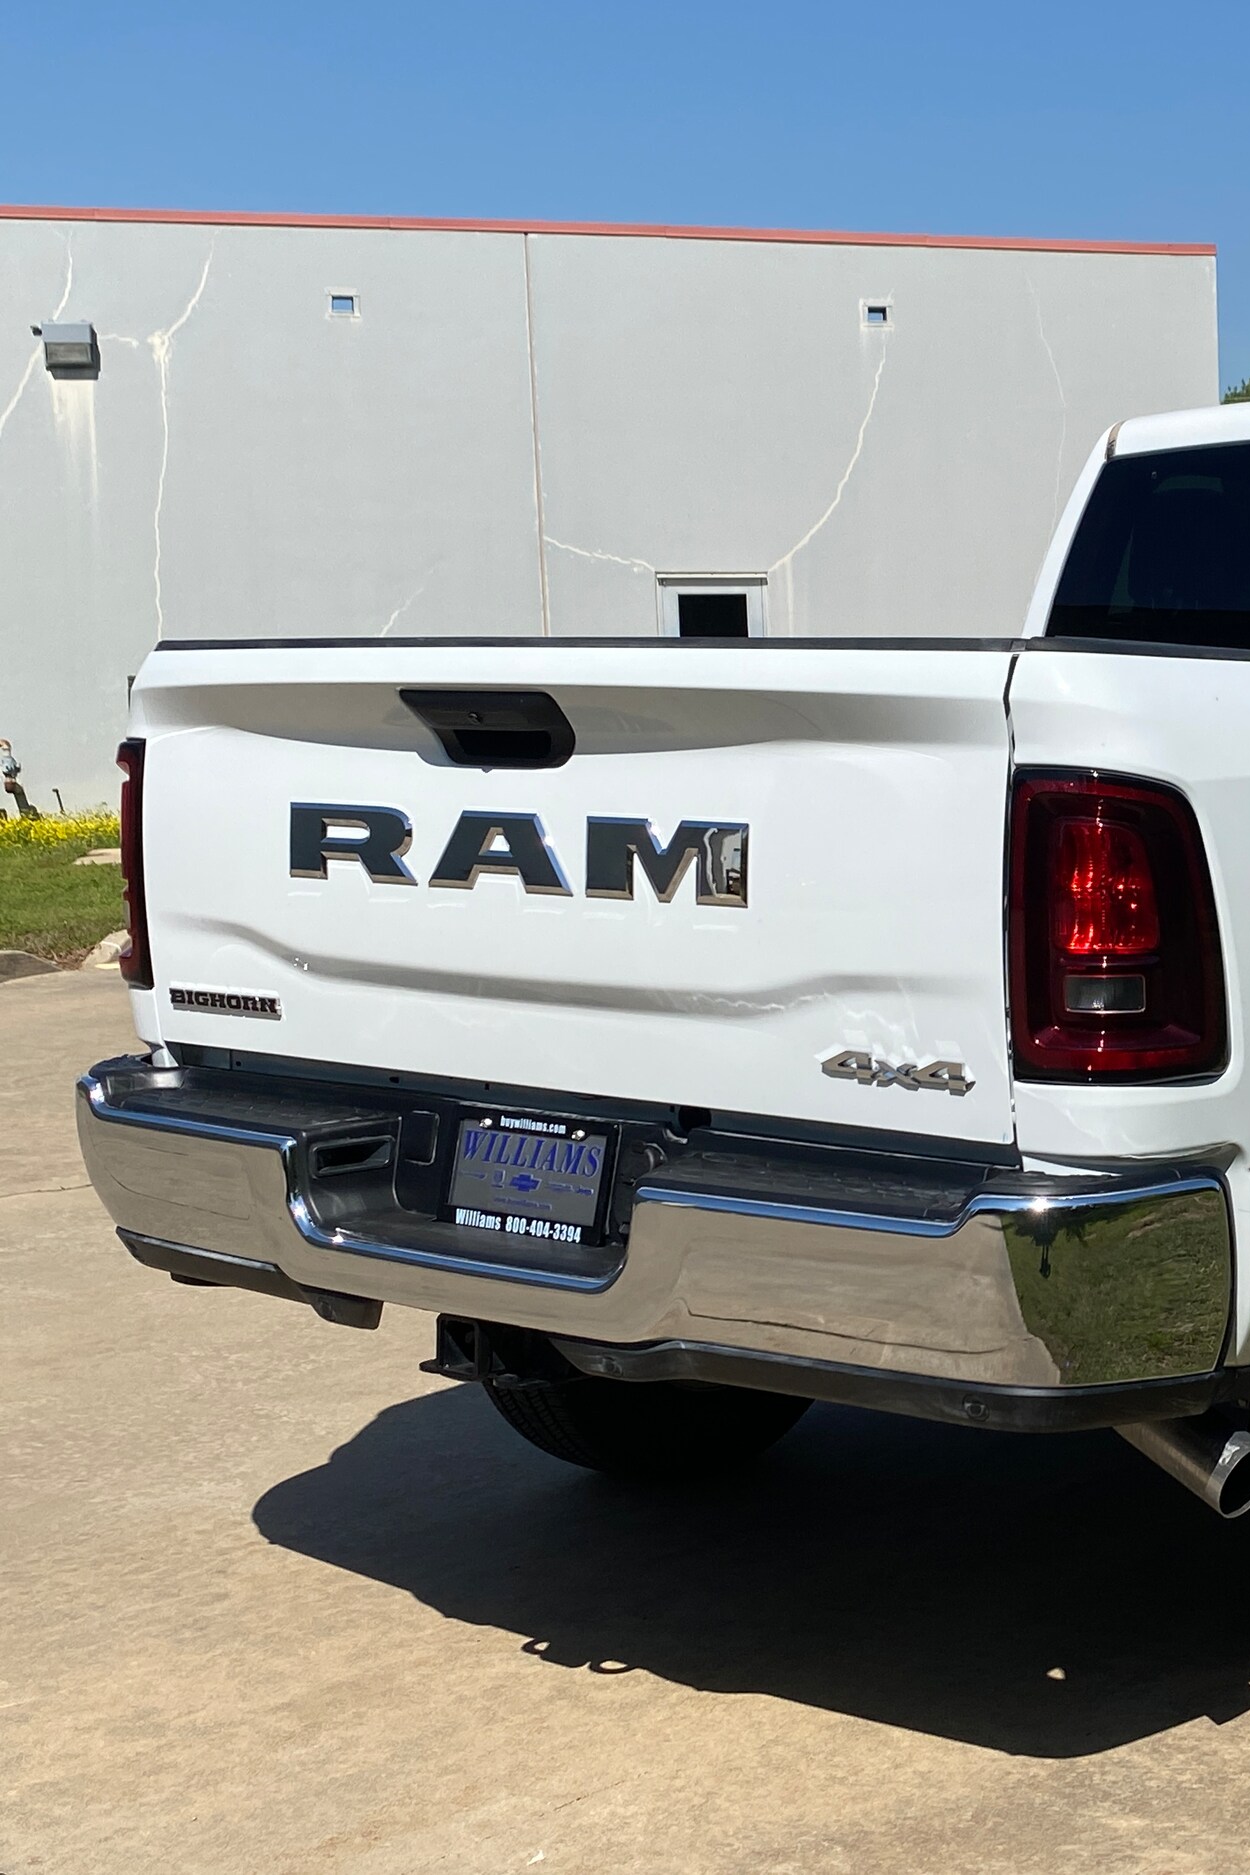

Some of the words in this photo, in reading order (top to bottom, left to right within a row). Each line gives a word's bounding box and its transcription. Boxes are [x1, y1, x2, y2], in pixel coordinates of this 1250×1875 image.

[290, 801, 749, 909] RAM
[169, 988, 282, 1021] BIGHORN
[500, 1115, 567, 1135] buywilliams.com
[463, 1129, 602, 1178] WILLIAMS
[455, 1208, 501, 1230] Williams
[505, 1215, 582, 1244] 800-404-3394
